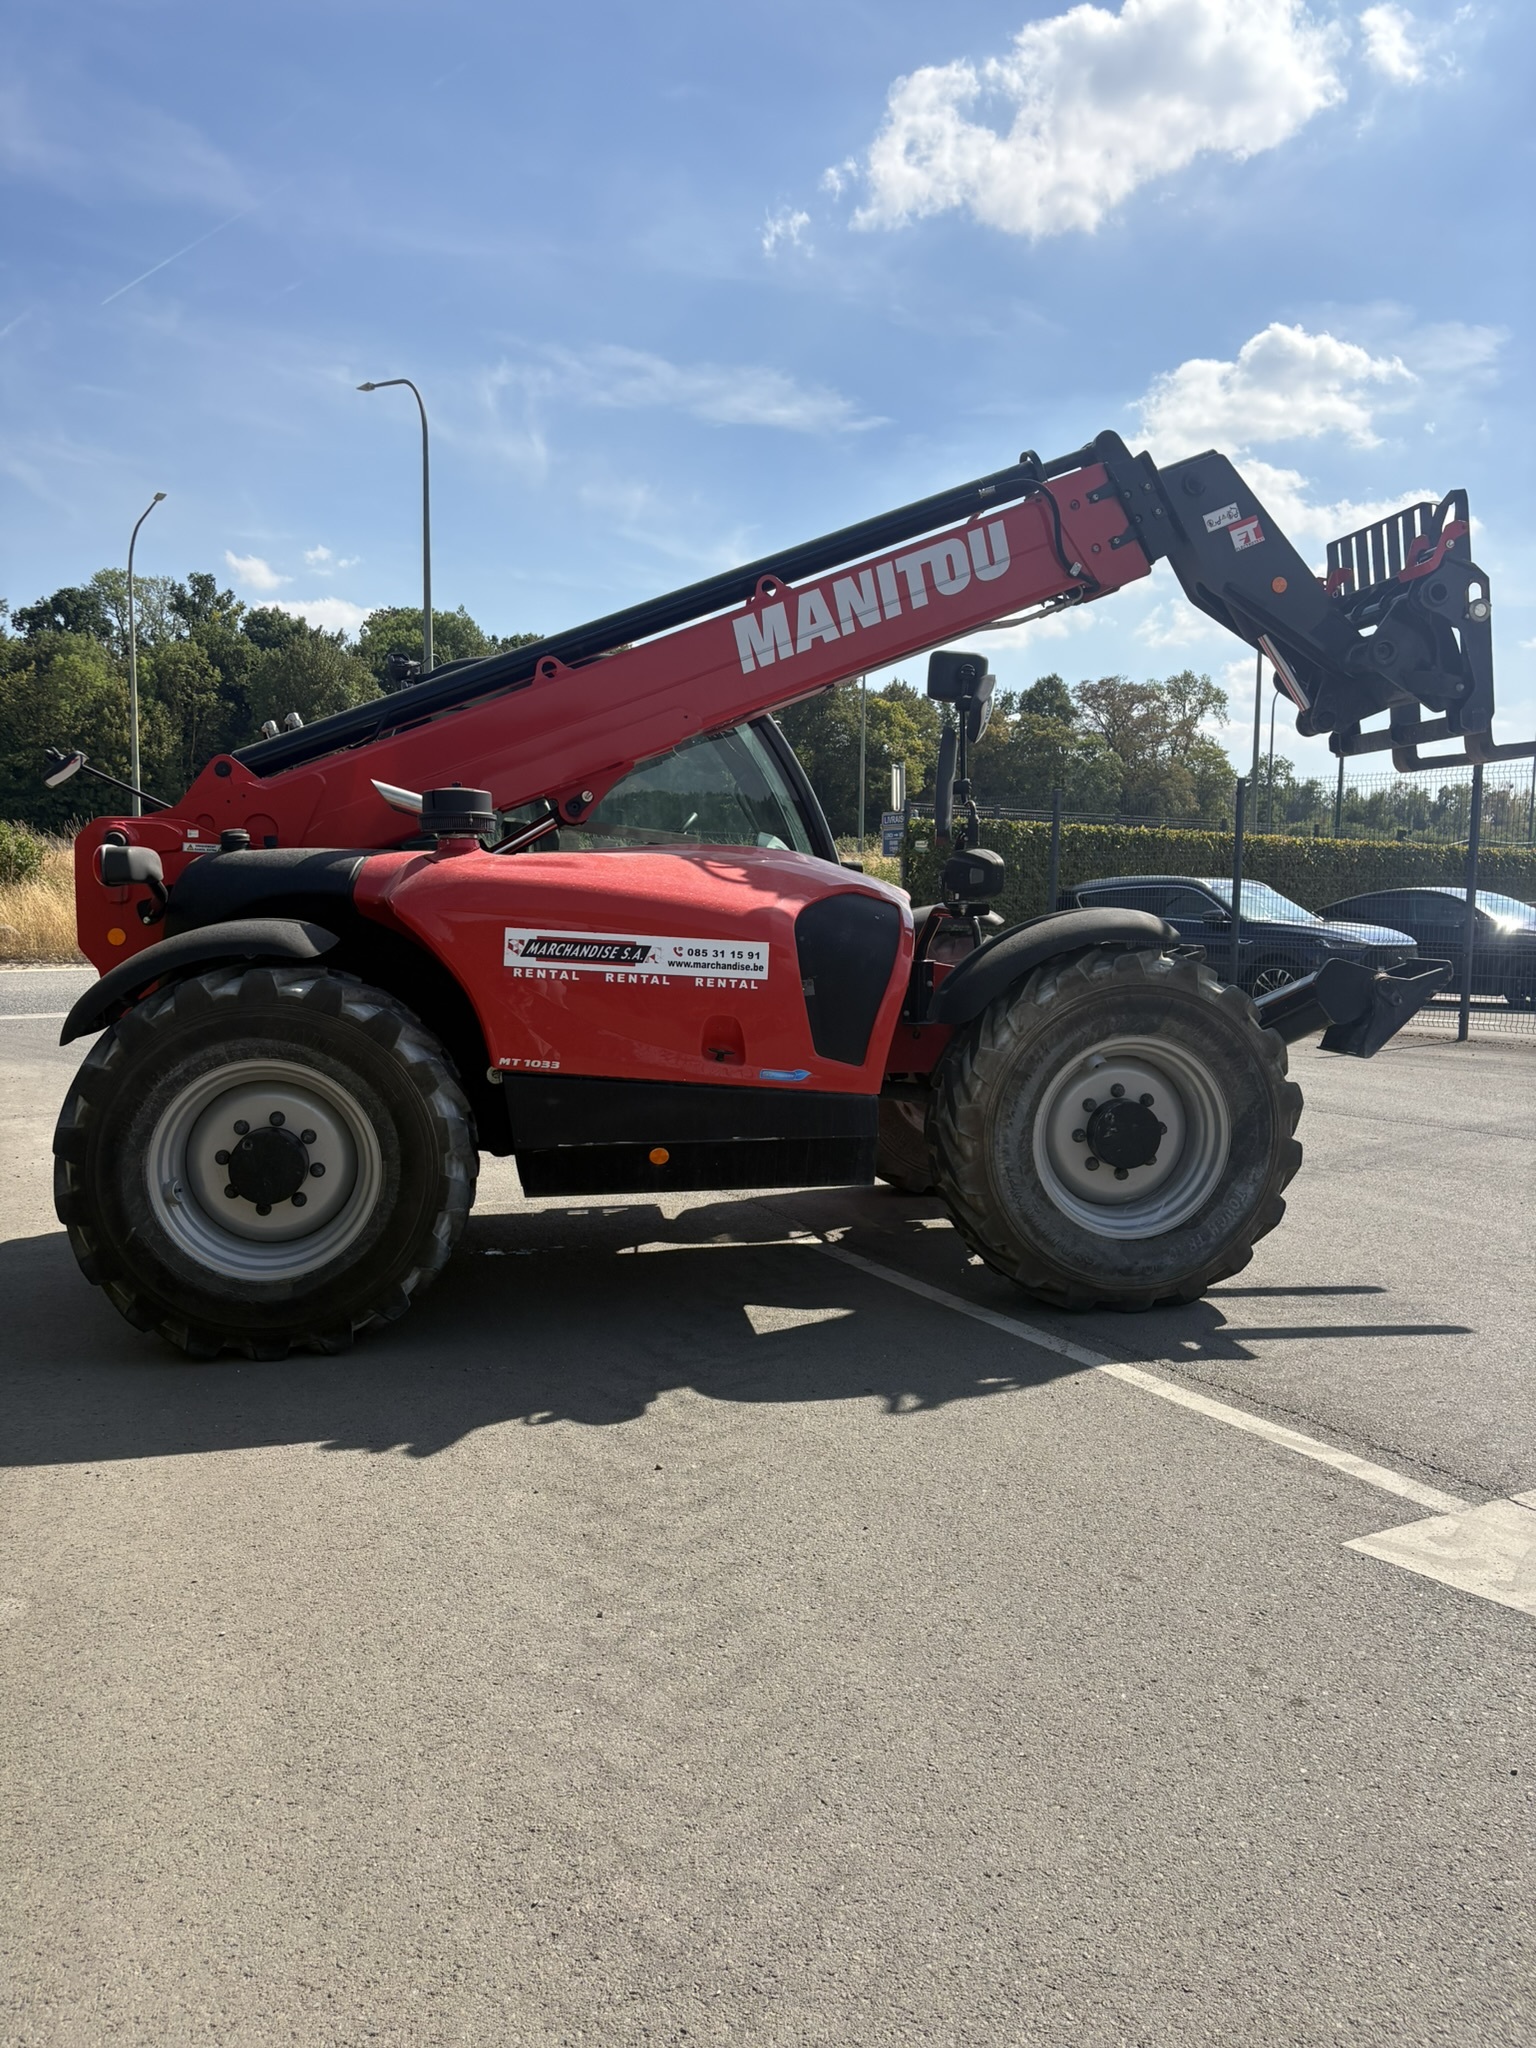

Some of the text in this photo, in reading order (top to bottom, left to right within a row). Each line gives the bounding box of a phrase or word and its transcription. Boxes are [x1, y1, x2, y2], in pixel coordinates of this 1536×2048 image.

[732, 520, 1011, 675] MANITOU
[885, 815, 904, 824] LIVRAIS
[526, 942, 644, 961] MARCHANDISE S.A.
[687, 948, 760, 960] 085 31 15 91
[668, 960, 764, 972] www.marchandise.be
[513, 968, 758, 989] RENTAL RENTAL RENTAL
[499, 1057, 560, 1070] MT 1033
